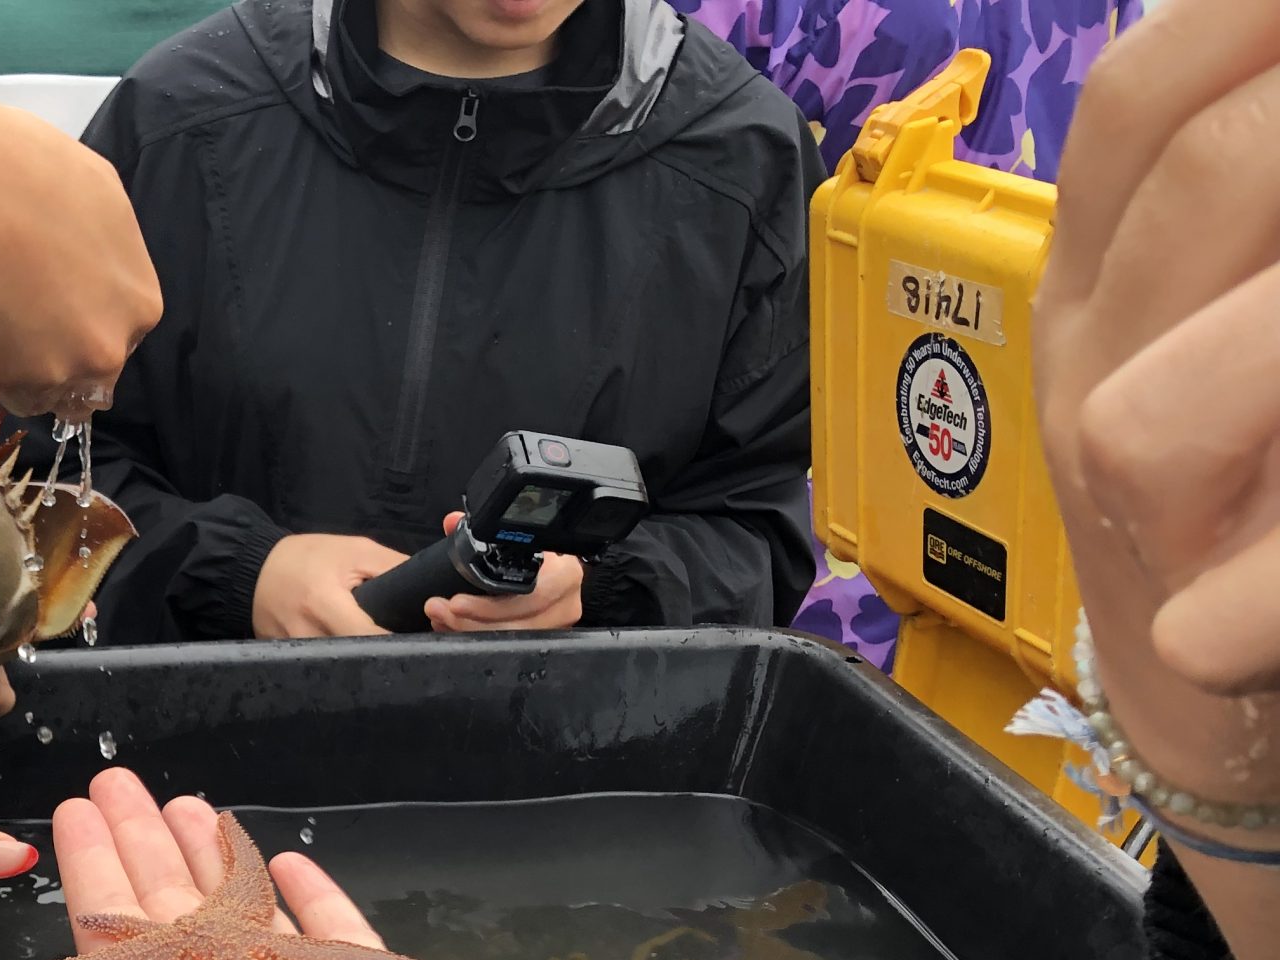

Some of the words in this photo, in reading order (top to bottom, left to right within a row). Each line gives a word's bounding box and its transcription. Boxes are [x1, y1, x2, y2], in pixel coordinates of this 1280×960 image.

[902, 276, 982, 331] 17418
[905, 357, 915, 374] 50
[913, 343, 932, 361] Years
[932, 342, 941, 354] in
[942, 342, 981, 401] Underwater
[900, 373, 914, 447] Celebrating
[916, 393, 968, 431] EdgeTech
[928, 422, 953, 462] 50
[968, 405, 986, 475] Technology
[912, 450, 969, 491] EdgeTech.com
[947, 546, 963, 561] ORE
[963, 555, 1003, 582] OFFSHORE
